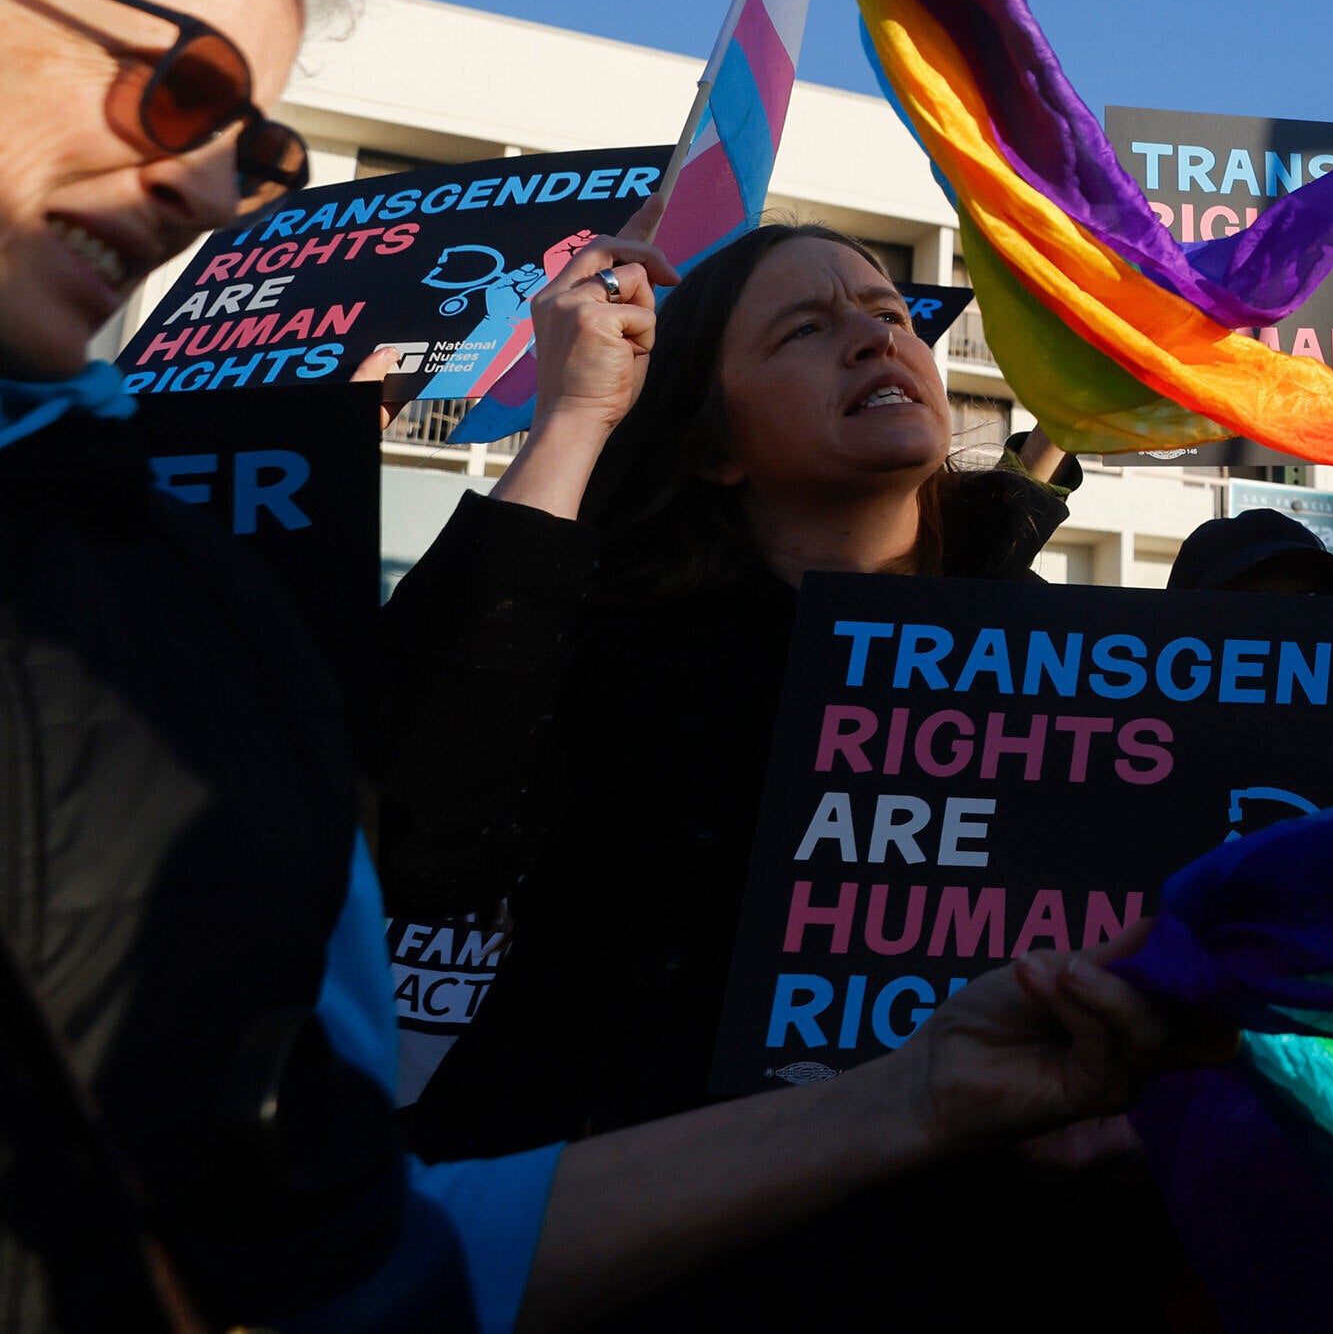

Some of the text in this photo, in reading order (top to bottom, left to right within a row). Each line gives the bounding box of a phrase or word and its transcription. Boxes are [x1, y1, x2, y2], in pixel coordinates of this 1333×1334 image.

[195, 223, 421, 286] RIGHTS
[162, 275, 295, 325] ARE
[136, 301, 366, 365] HUMAN
[428, 352, 479, 362] Nurses
[433, 340, 497, 351] National
[424, 362, 474, 373] United
[1242, 494, 1268, 505] SAN
[814, 704, 1175, 786] RIGHTS
[794, 791, 997, 868] ARE
[782, 880, 1144, 959] HUMAN
[765, 973, 970, 1050] RIG
